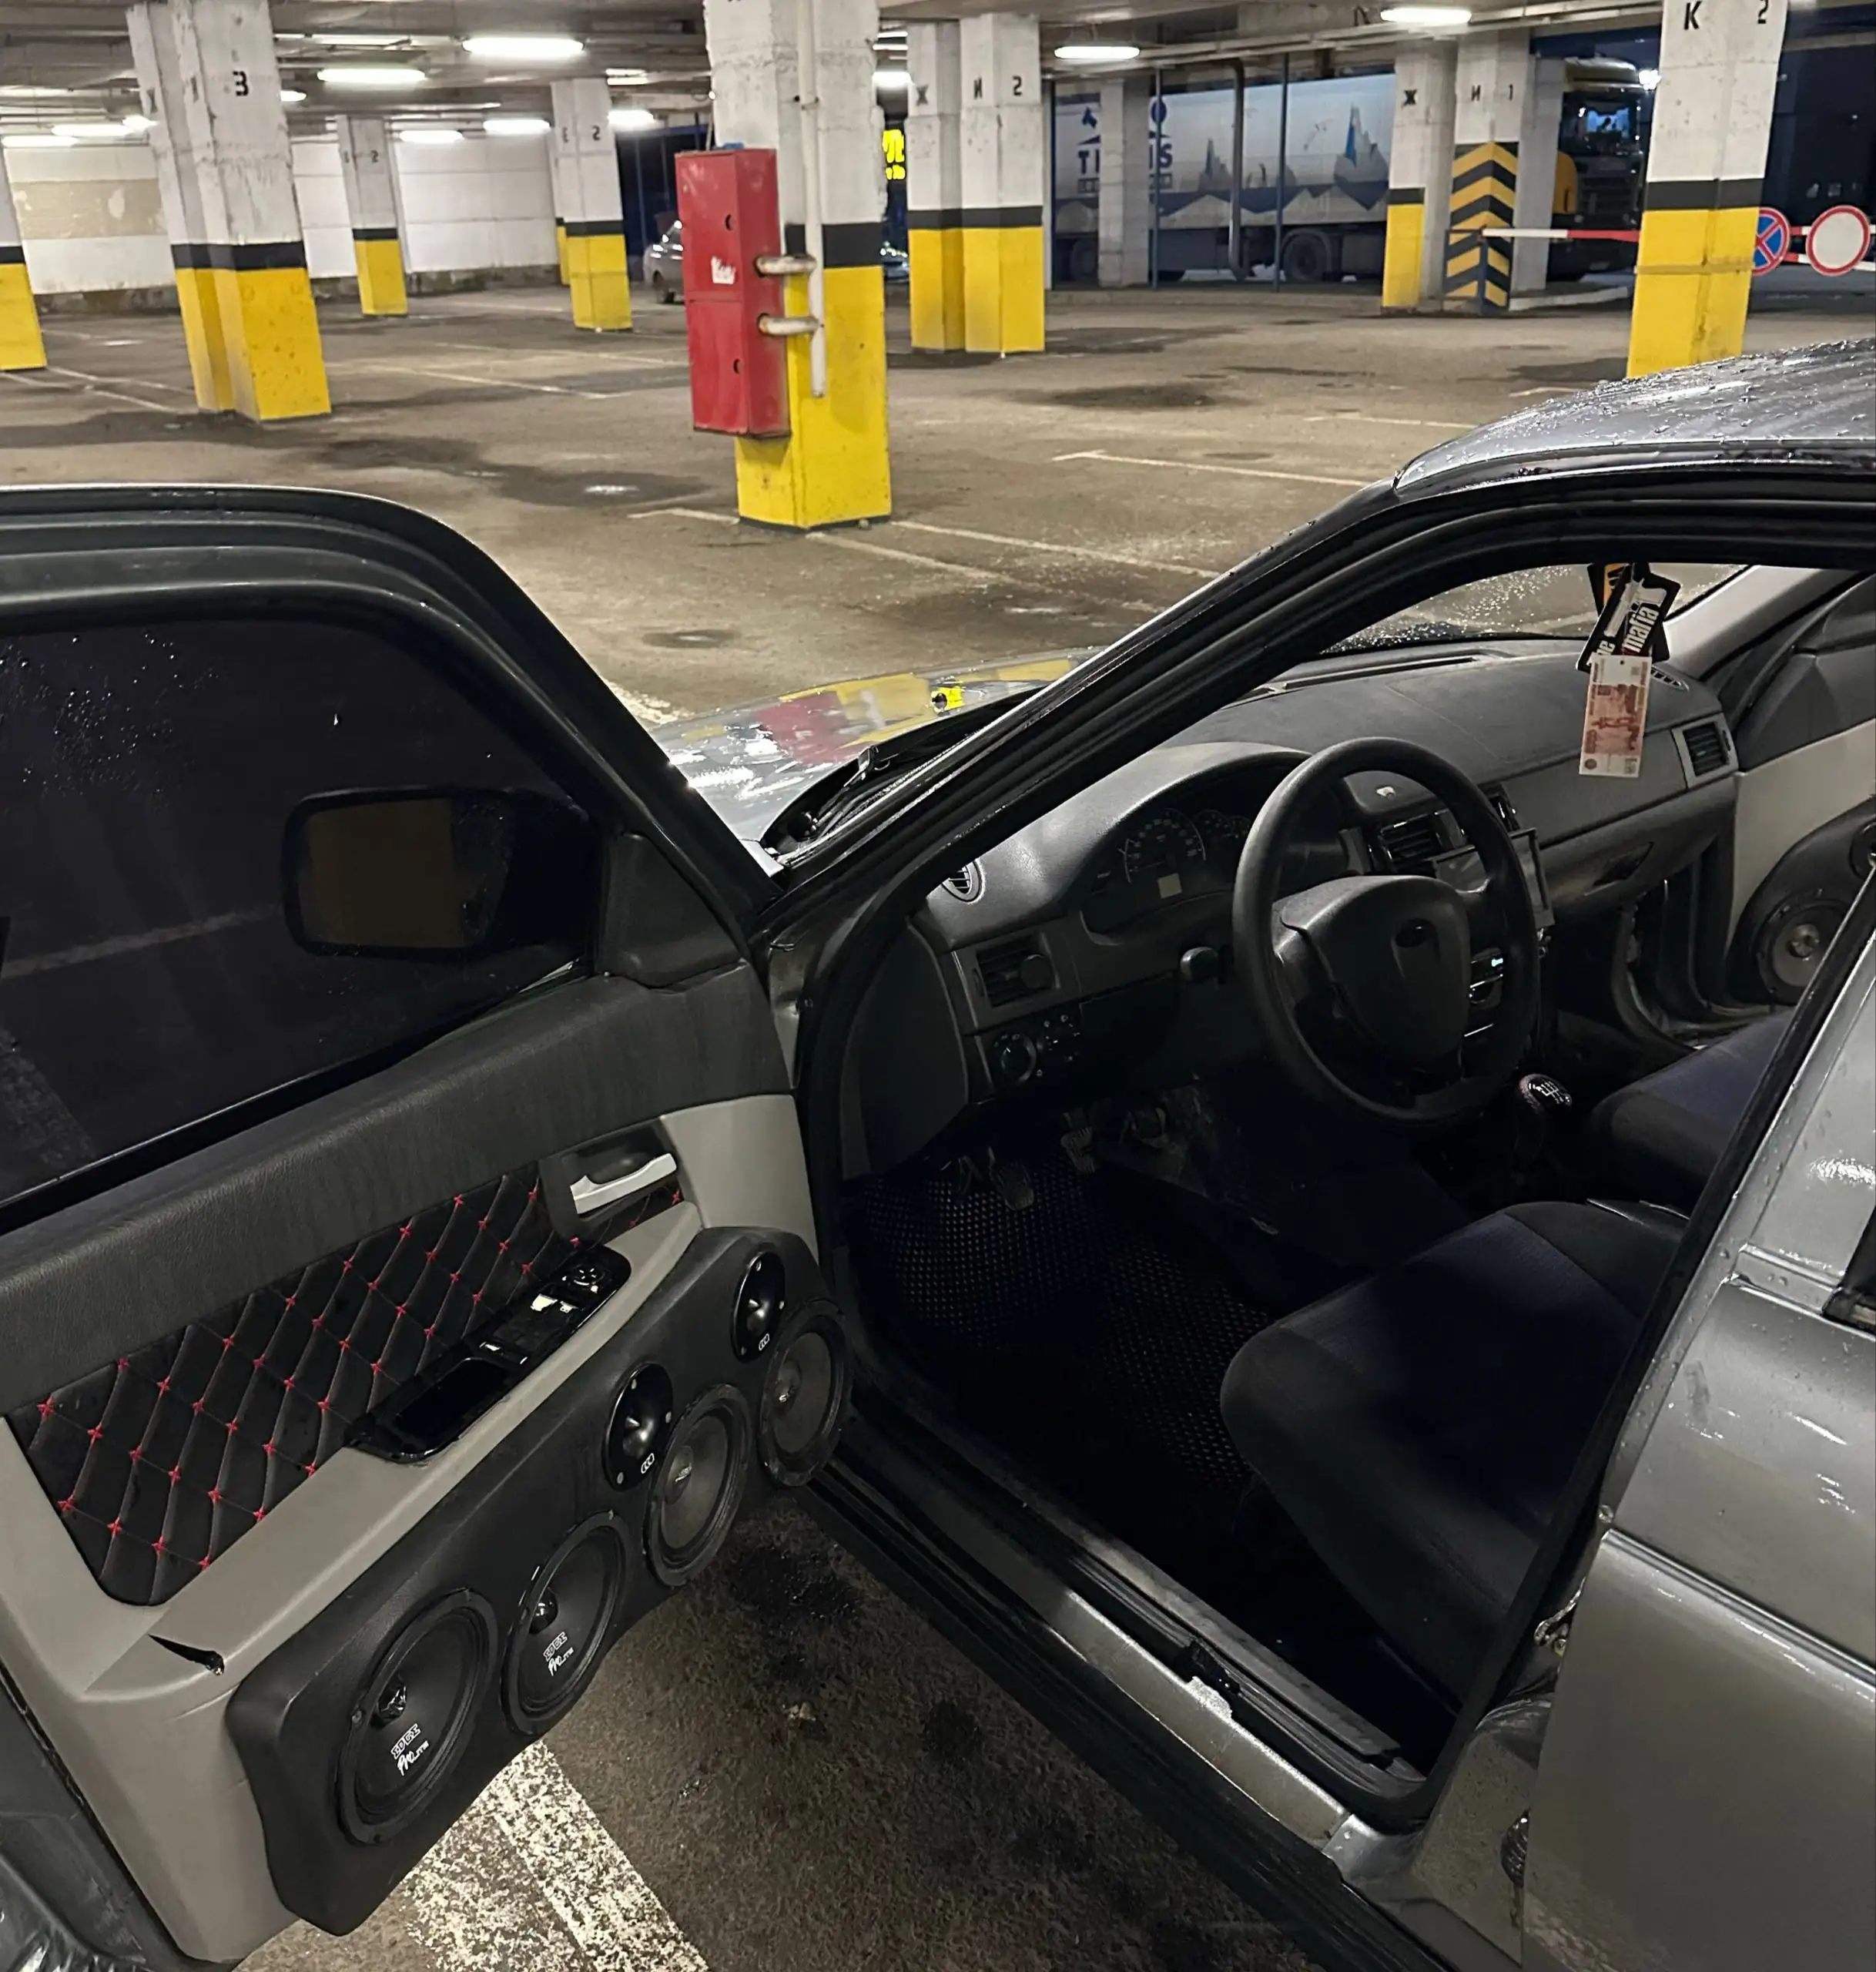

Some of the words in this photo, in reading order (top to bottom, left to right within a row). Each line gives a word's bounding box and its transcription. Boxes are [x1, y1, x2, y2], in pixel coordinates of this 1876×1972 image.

[1684, 0, 1702, 30] К
[1757, 0, 1768, 24] 2
[233, 71, 249, 96] 3
[1012, 75, 1023, 96] 2
[591, 125, 600, 141] 2
[370, 149, 379, 163] 2
[1622, 606, 1660, 652] mafia
